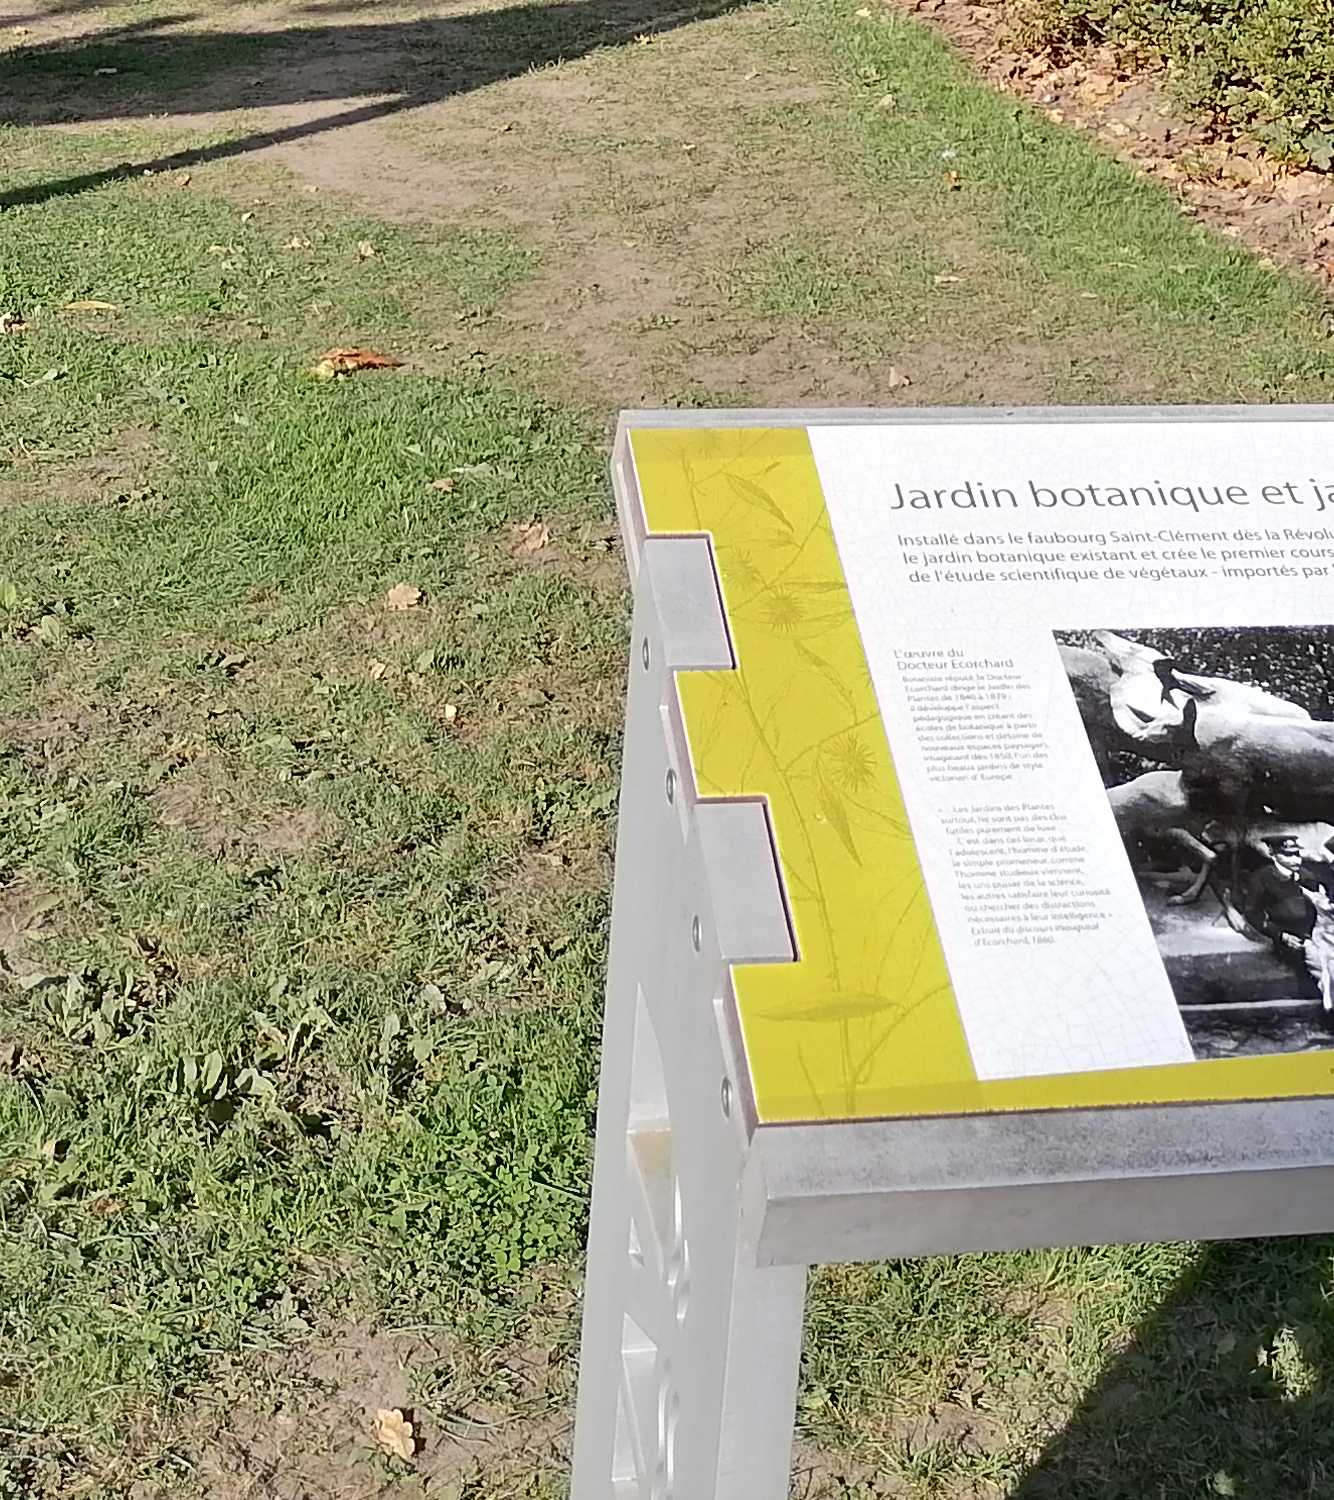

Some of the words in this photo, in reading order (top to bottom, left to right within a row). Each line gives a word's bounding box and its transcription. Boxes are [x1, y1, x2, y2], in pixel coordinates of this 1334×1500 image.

[890, 480, 1018, 509] Jardin
[1027, 479, 1249, 512] botanique
[1261, 481, 1304, 504] et
[897, 532, 959, 546] Installé
[963, 531, 1004, 545] dans
[1007, 531, 1023, 544] le
[1026, 531, 1106, 545] faubourg
[1109, 529, 1229, 543] Saint-Clément
[1232, 528, 1262, 540] dès
[1264, 528, 1280, 540] la
[902, 551, 918, 564] le
[922, 550, 972, 567] jardin
[975, 550, 1065, 564] botanique
[1069, 549, 1137, 561] existant
[1140, 550, 1158, 560] et
[1161, 547, 1197, 560] crée
[1199, 547, 1217, 559] le
[1220, 546, 1284, 562] premier
[1290, 548, 1334, 558] cours
[908, 569, 930, 582] de
[934, 568, 995, 582] l'étude
[999, 567, 1098, 582] scientifique
[1103, 566, 1125, 579] de
[1128, 566, 1208, 581] végétaux
[1220, 564, 1298, 580] importés
[1301, 566, 1328, 579] par
[893, 649, 944, 658] L'œuvre
[947, 647, 964, 657] du
[896, 660, 947, 670] Docteur
[950, 658, 1013, 669] Ecorchard
